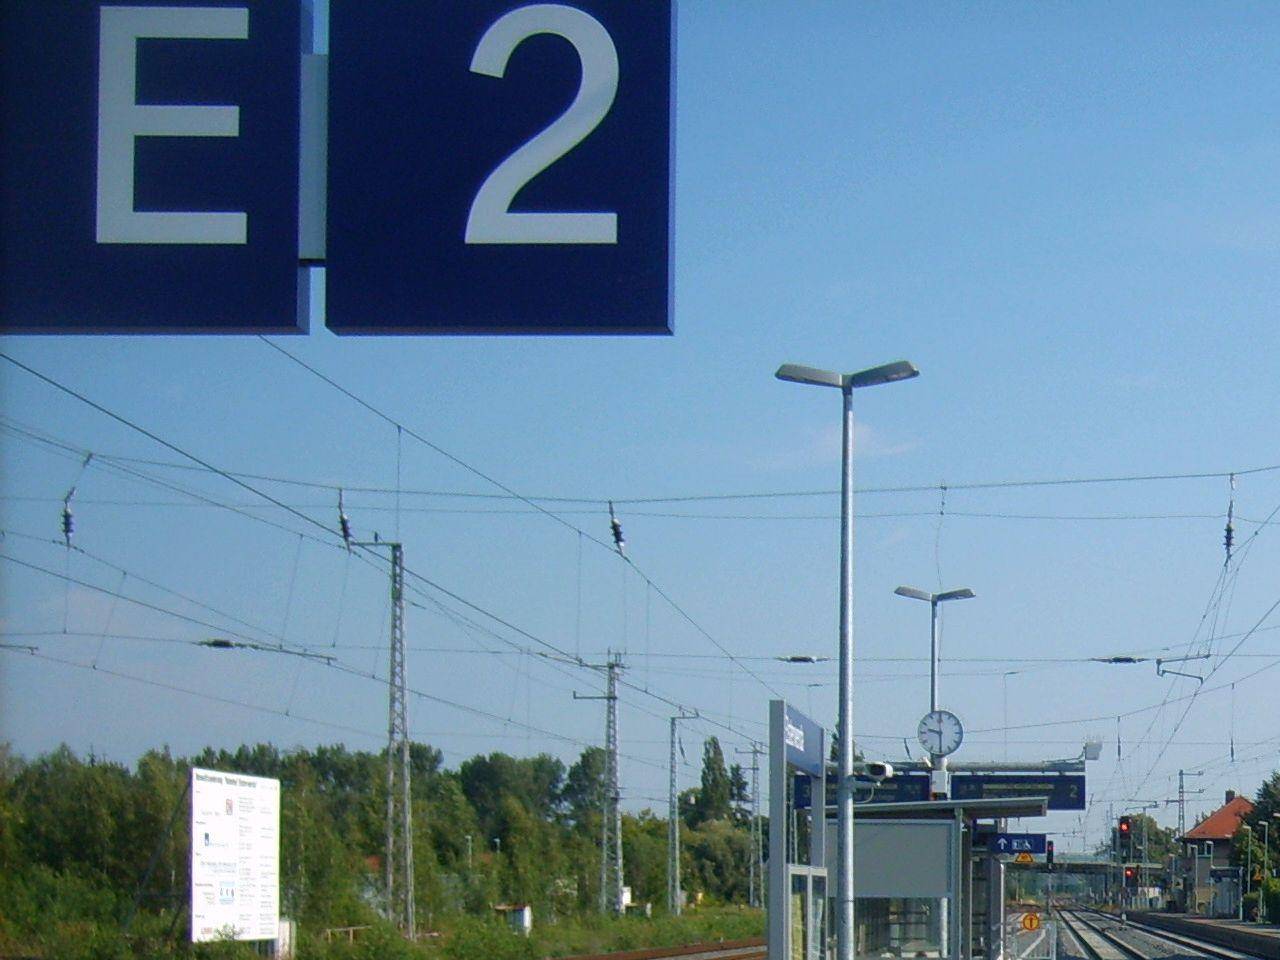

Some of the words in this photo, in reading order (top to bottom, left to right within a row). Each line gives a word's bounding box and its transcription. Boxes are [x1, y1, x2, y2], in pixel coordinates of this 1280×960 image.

[96, 5, 249, 244] E
[464, 3, 620, 245] 2
[1069, 784, 1079, 797] 2
